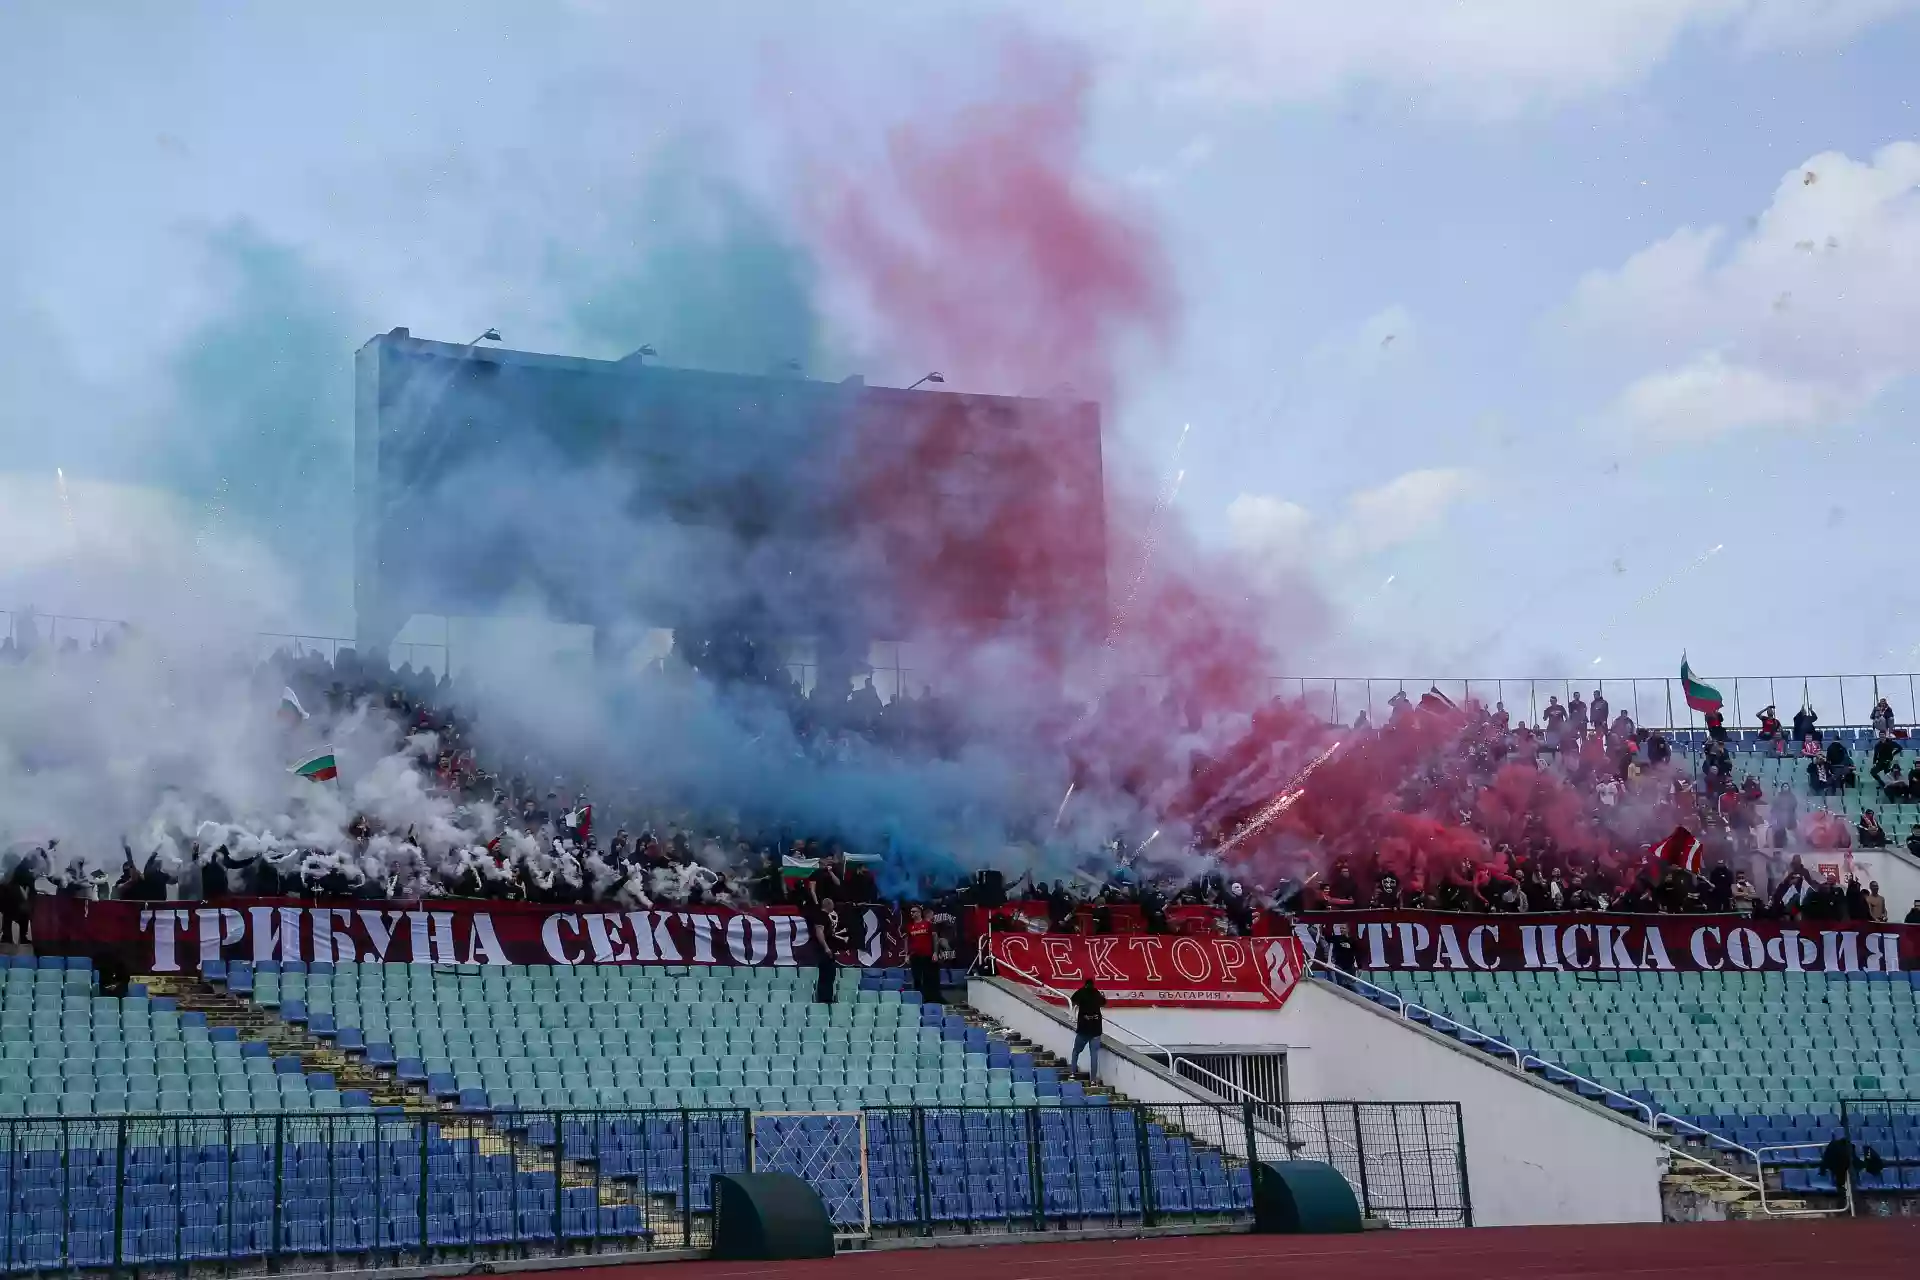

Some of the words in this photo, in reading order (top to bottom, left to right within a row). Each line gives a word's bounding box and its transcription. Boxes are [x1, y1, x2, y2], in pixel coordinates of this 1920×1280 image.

[140, 907, 512, 971] ТРИБУНА
[541, 911, 811, 966] СЕКТОР
[1001, 935, 1246, 983] СЕКТОР
[1519, 924, 1675, 972] ЦСКА
[1690, 926, 1899, 973] СОФИЯ
[1158, 990, 1222, 1000] БЪЛГАРИЯ
